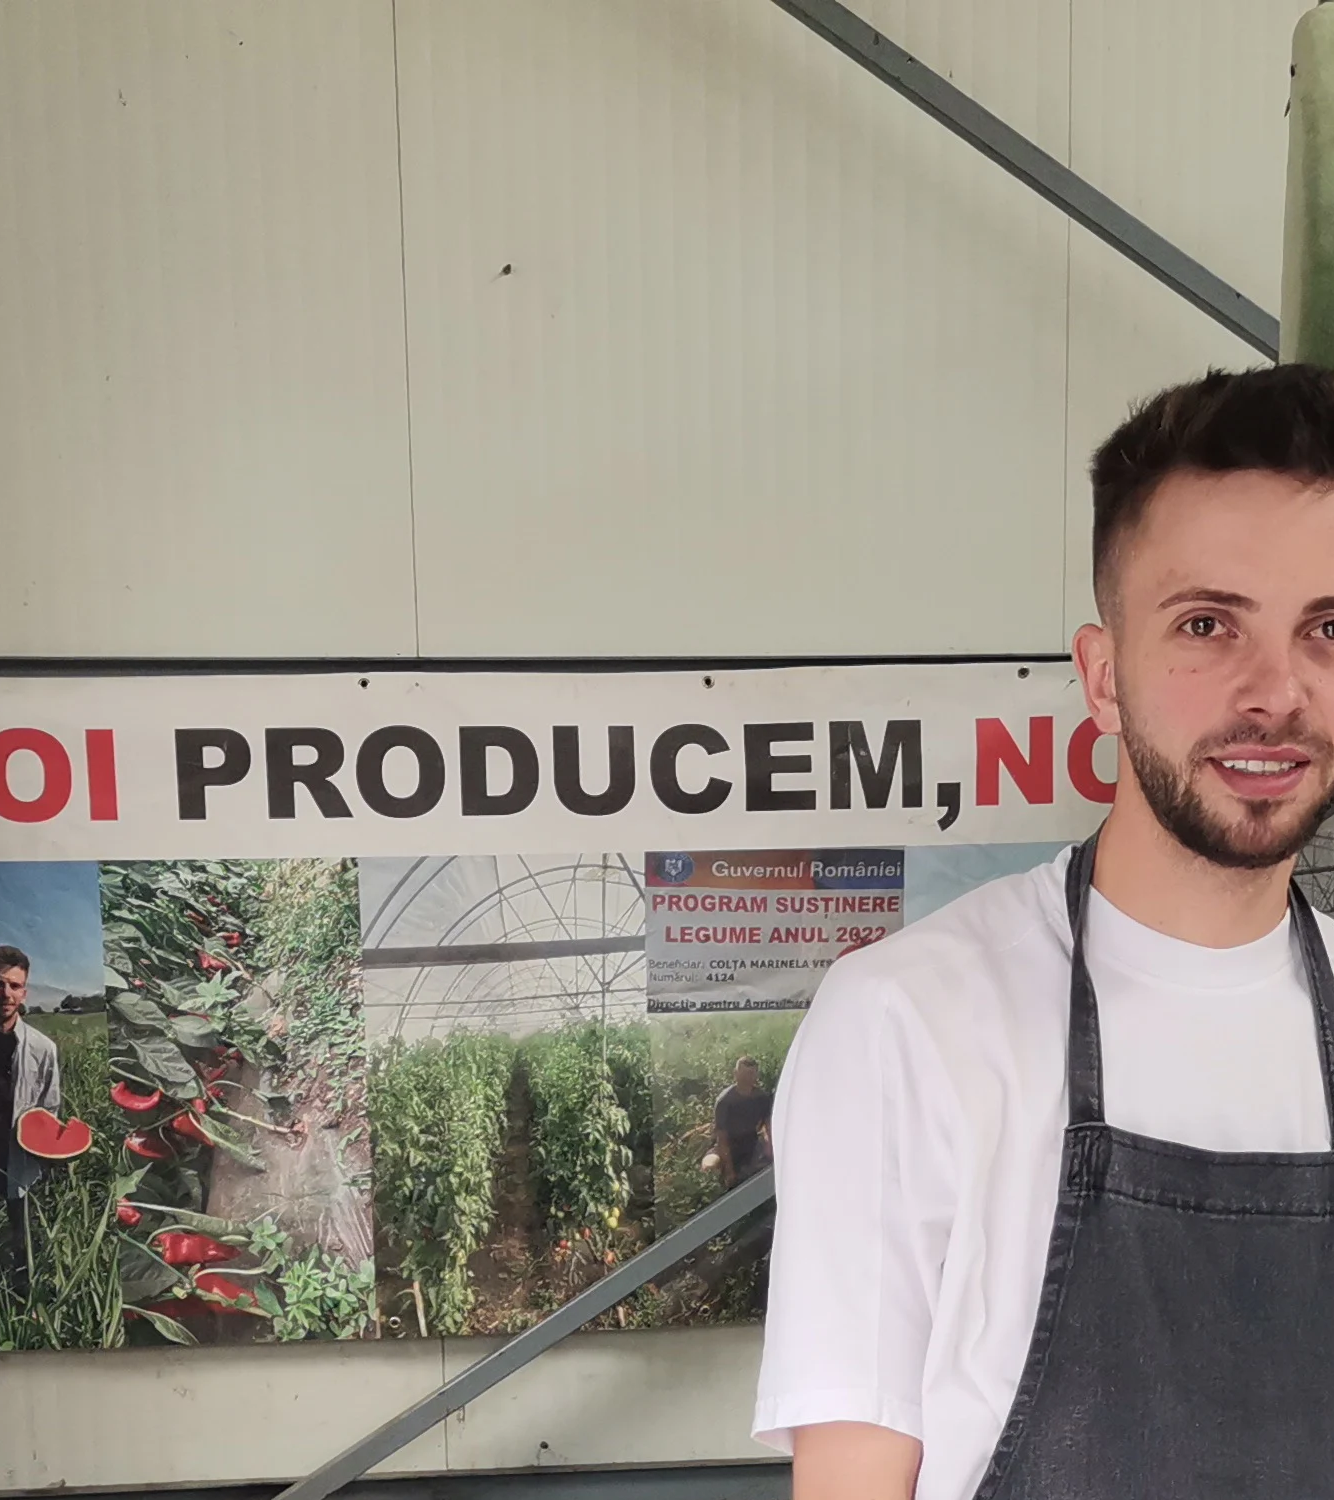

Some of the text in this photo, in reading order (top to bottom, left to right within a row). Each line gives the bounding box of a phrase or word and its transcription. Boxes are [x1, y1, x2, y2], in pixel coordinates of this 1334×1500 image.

[174, 720, 960, 831] PRODUCEM,
[974, 715, 1119, 806] NO
[712, 860, 902, 878] Guvernul României
[652, 894, 767, 913] PROGRAM
[665, 926, 887, 943] LEGUME ANUL 2022
[750, 959, 809, 969] MARINELA
[706, 973, 734, 982] 4124
